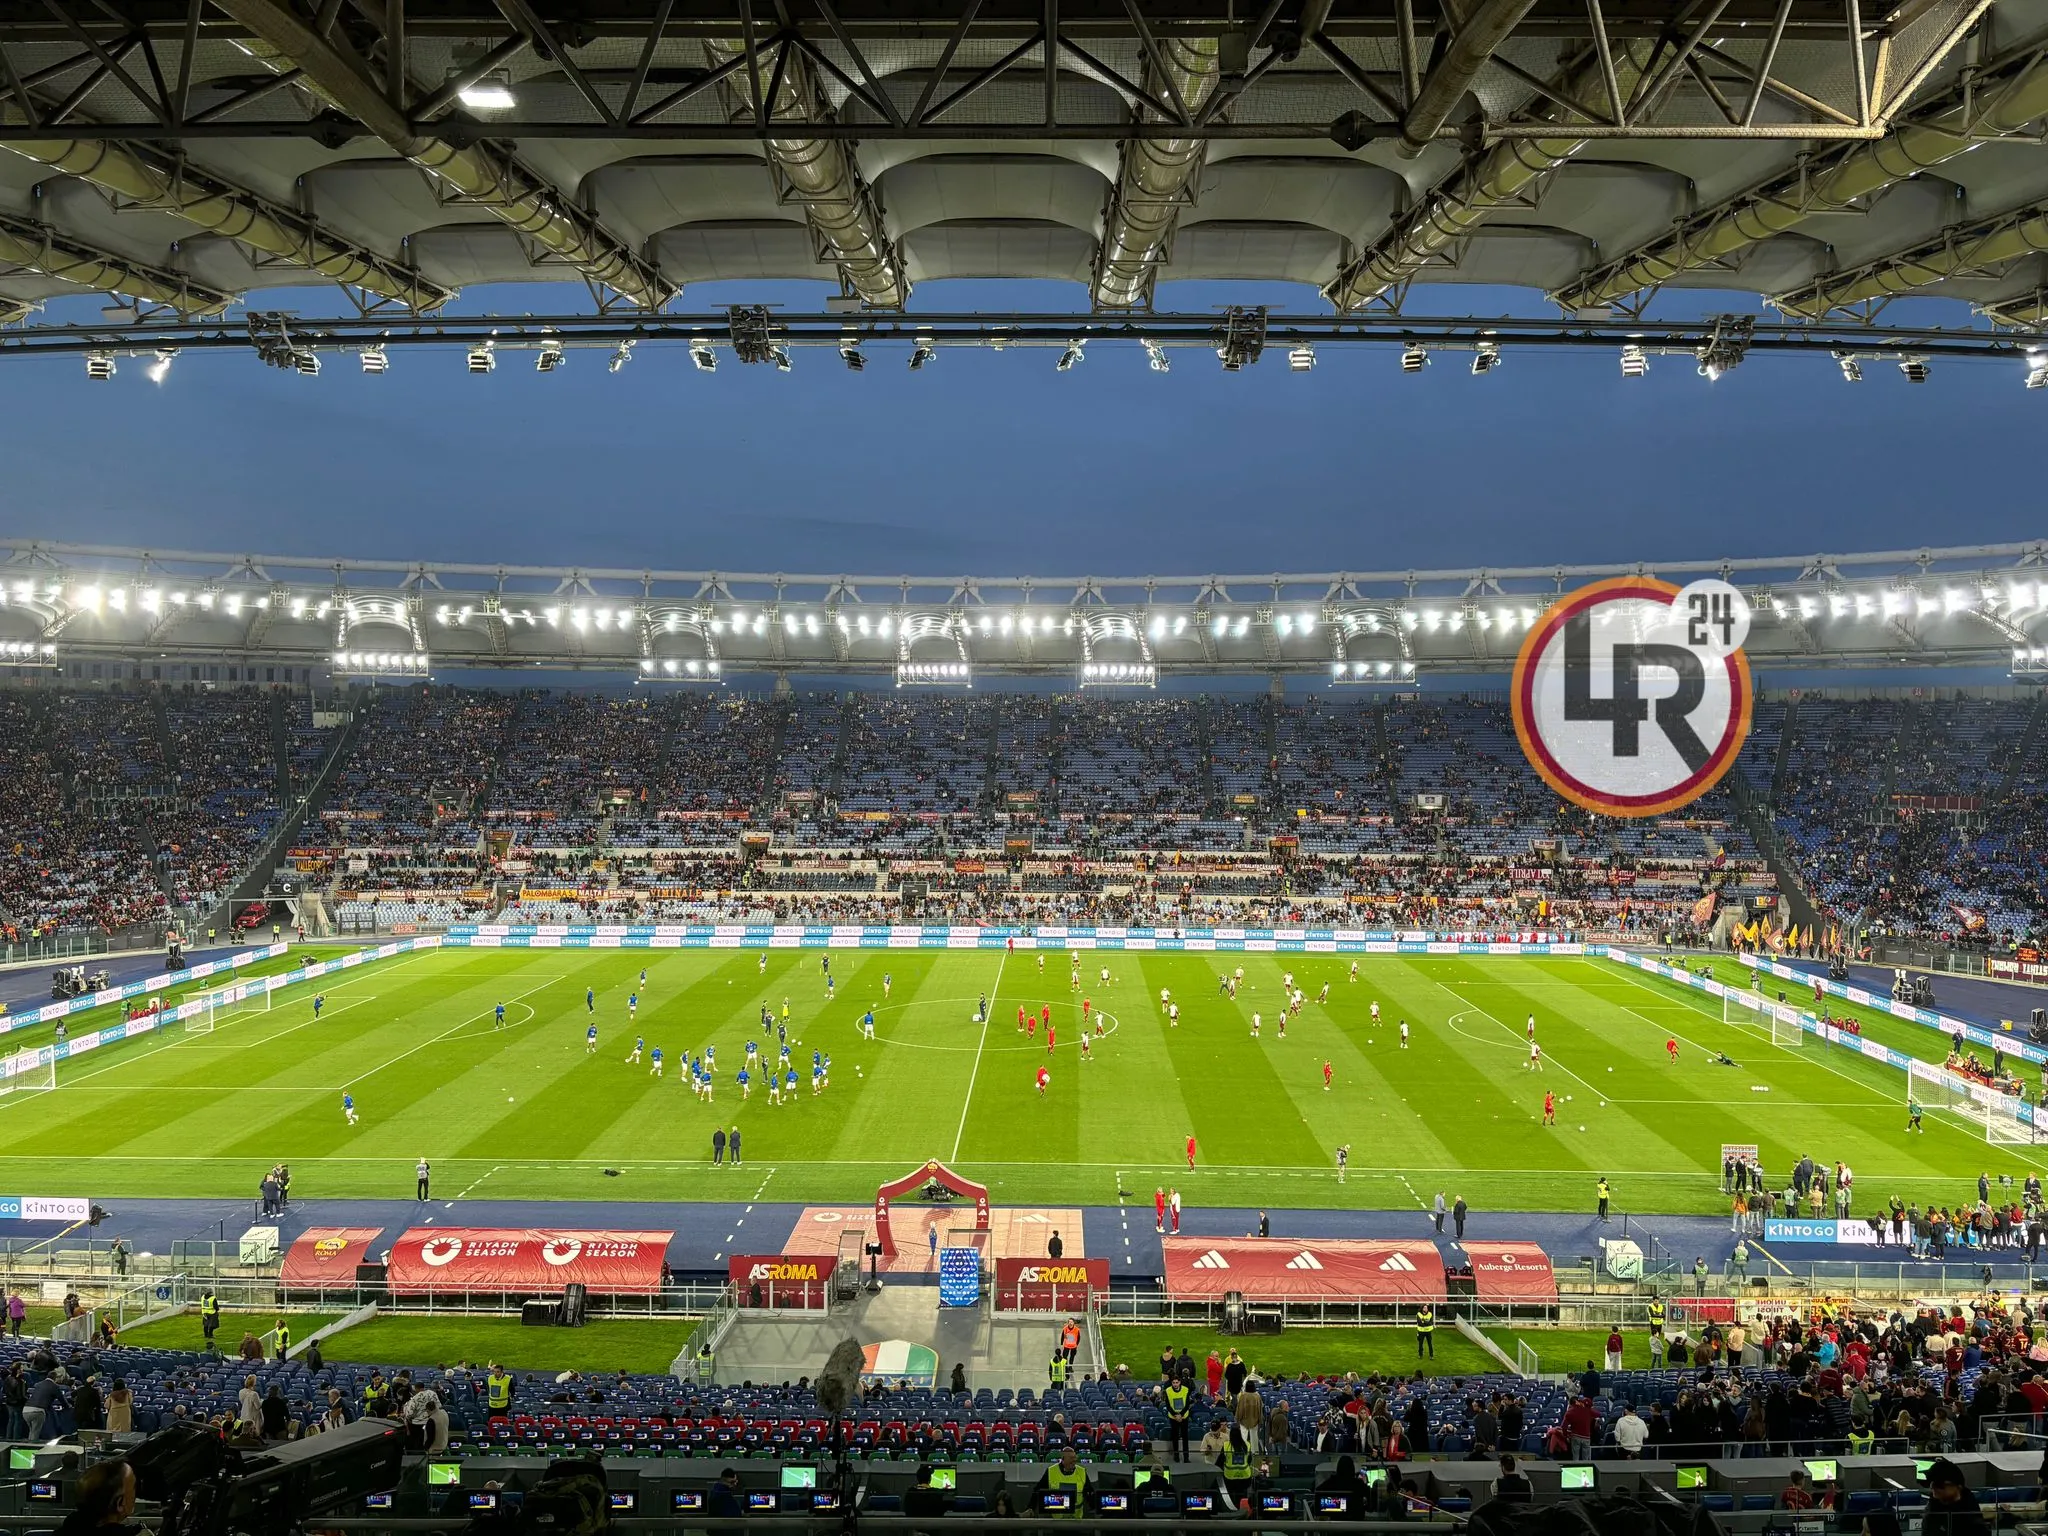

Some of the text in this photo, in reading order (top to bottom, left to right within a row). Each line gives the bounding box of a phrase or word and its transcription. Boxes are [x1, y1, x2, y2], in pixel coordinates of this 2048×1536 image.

[1054, 862, 1080, 872] SPR
[1509, 868, 1536, 879] APRILE
[283, 884, 292, 892] C
[649, 888, 702, 897] VIMINALE
[522, 889, 567, 898] PALOMBARA
[579, 890, 602, 898] MALTA
[0, 1203, 18, 1213] GO
[68, 1205, 85, 1214] GO
[1814, 1227, 1834, 1236] GO
[1843, 1225, 1873, 1237] KINT
[588, 1242, 638, 1250] RIYADH
[466, 1248, 516, 1257] SEASON
[586, 1249, 636, 1258] SEASON
[1478, 1263, 1512, 1273] Auberge
[1618, 1258, 1637, 1275] Sixtus
